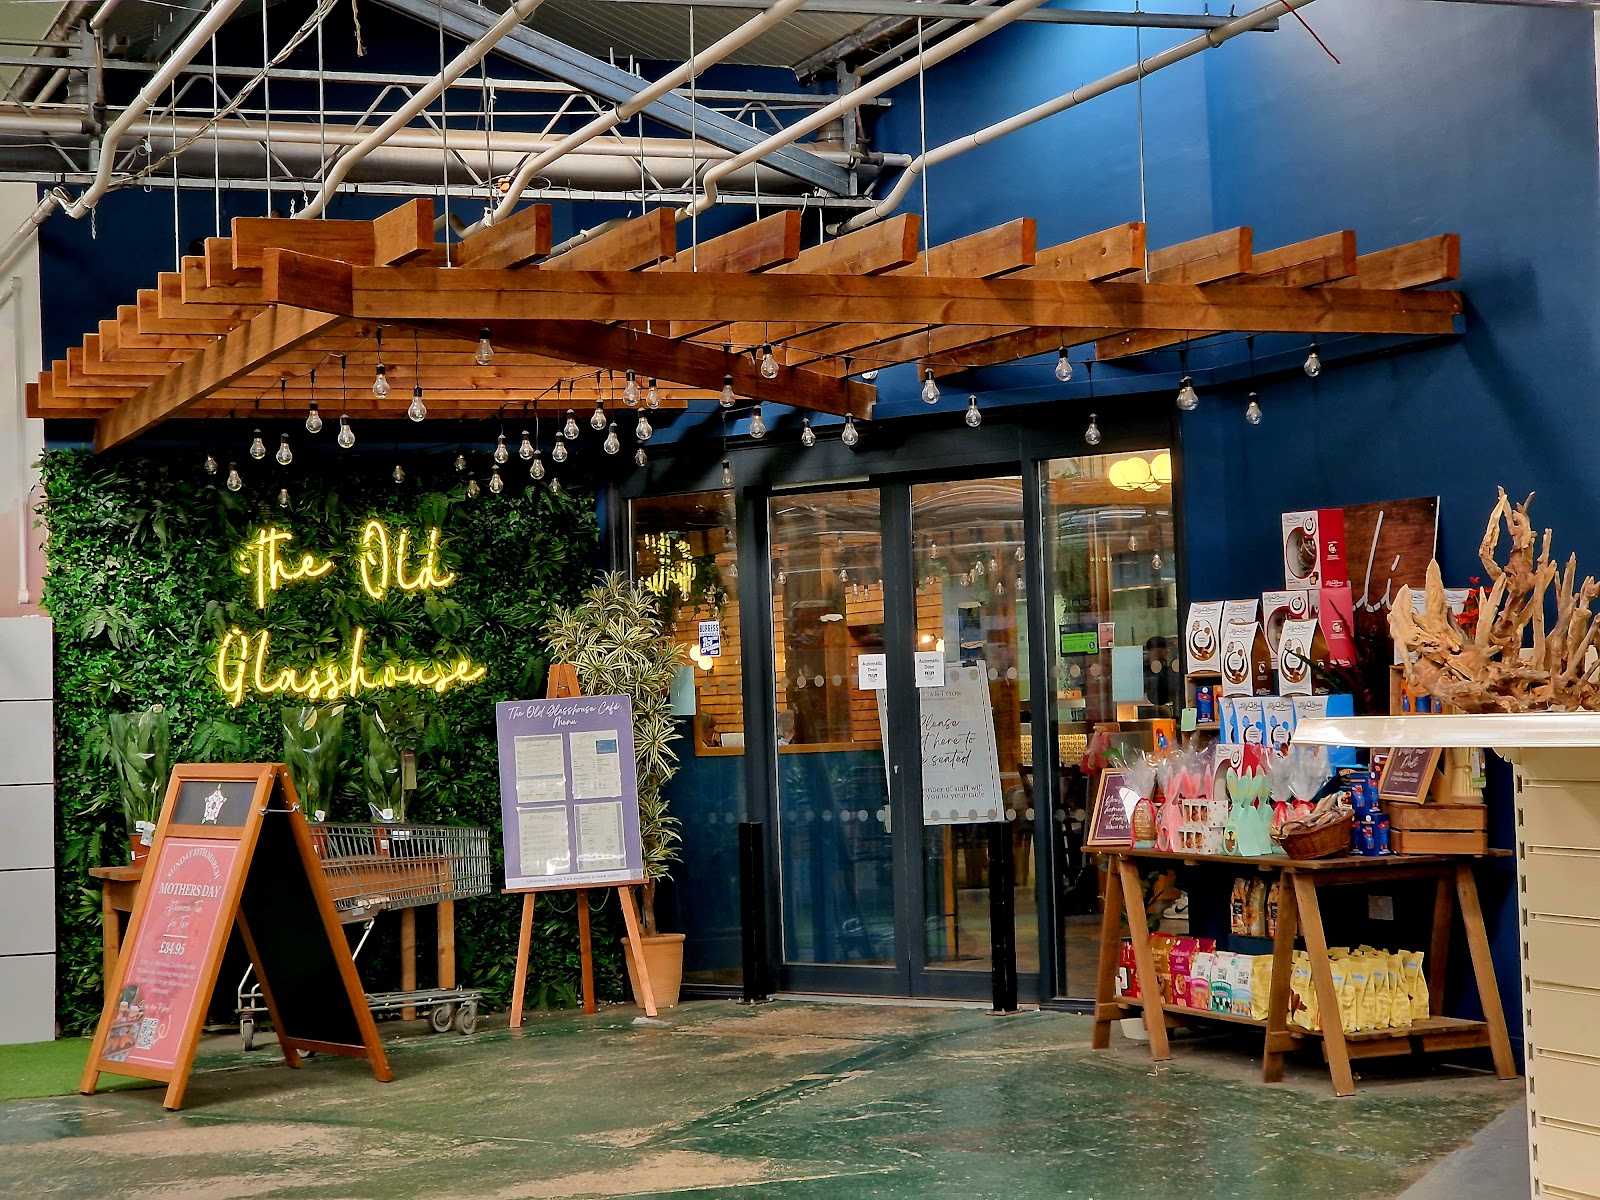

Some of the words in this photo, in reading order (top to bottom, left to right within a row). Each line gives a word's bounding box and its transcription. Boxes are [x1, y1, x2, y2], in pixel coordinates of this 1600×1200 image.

[238, 526, 334, 609] The
[359, 519, 454, 599] Old
[217, 626, 487, 708] Glasshouse
[508, 706, 524, 720] The
[526, 705, 546, 718] Old
[546, 703, 596, 718] Glasshouse
[598, 700, 620, 716] Café
[552, 717, 578, 729] Menu
[934, 732, 961, 750] here
[959, 731, 976, 750] to
[932, 749, 972, 770] seated
[158, 882, 202, 897] MOTHERS
[201, 884, 222, 898] DAY
[158, 941, 186, 956] £34.95
